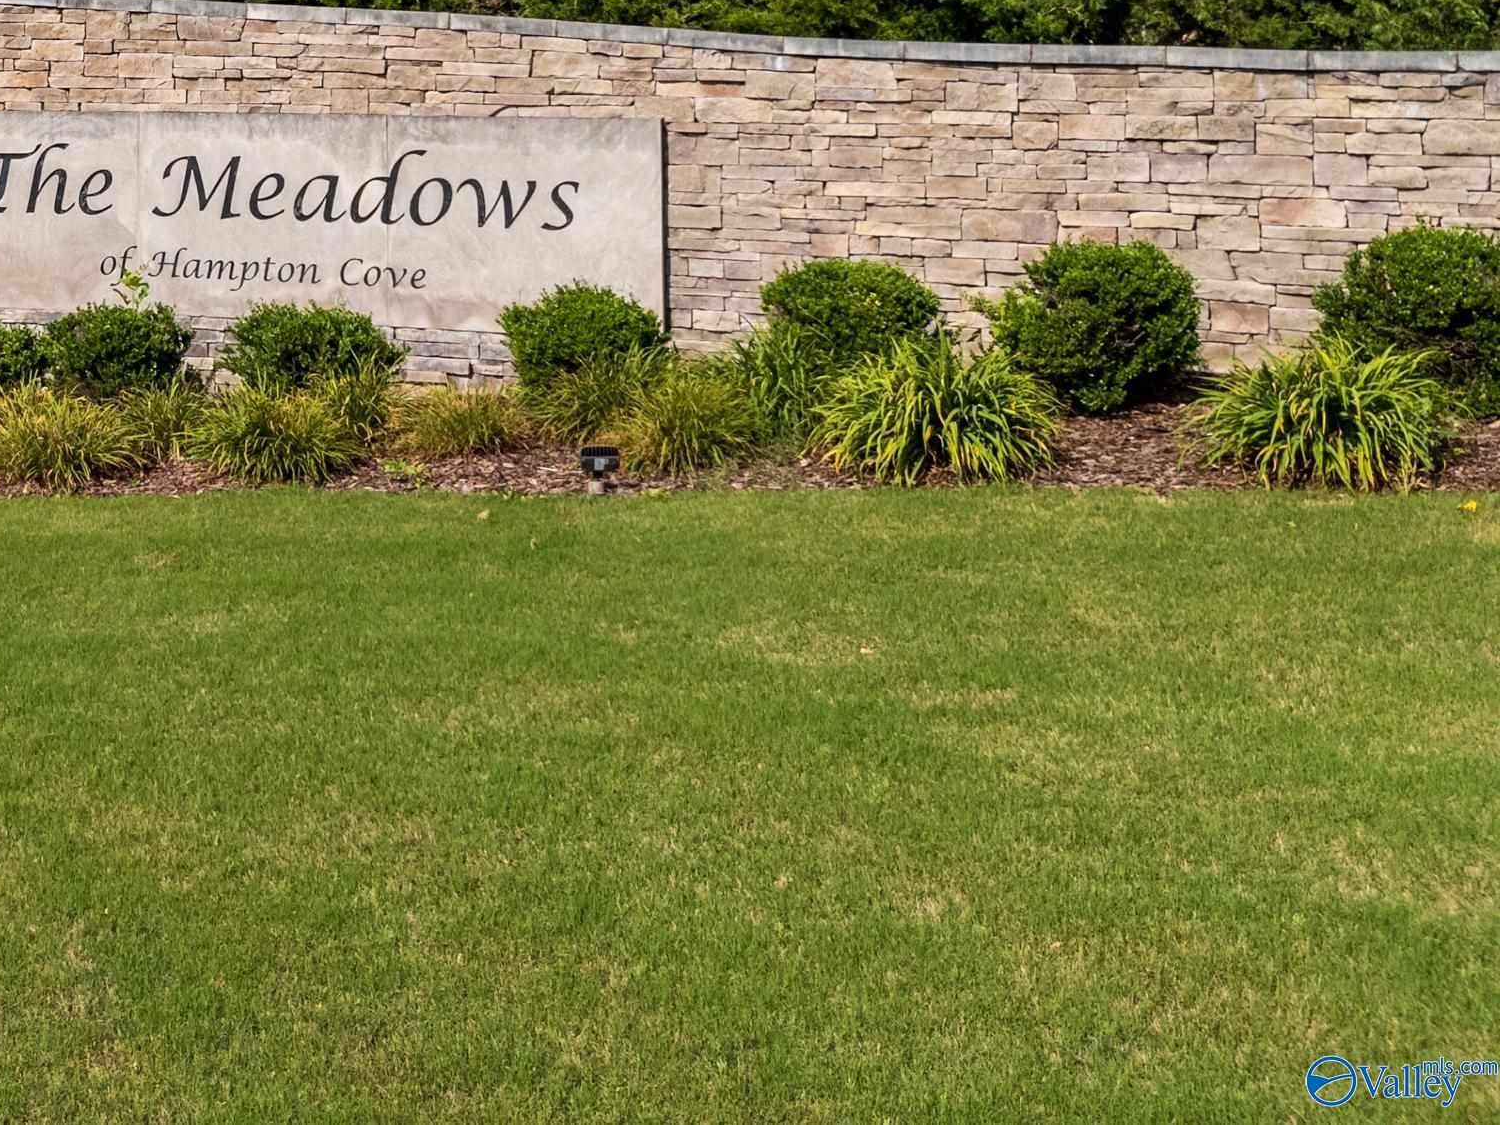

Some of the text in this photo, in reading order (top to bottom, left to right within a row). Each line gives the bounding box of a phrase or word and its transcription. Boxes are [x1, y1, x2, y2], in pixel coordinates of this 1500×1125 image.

[151, 148, 581, 231] Meadows
[99, 245, 427, 291] of Hampton Cove
